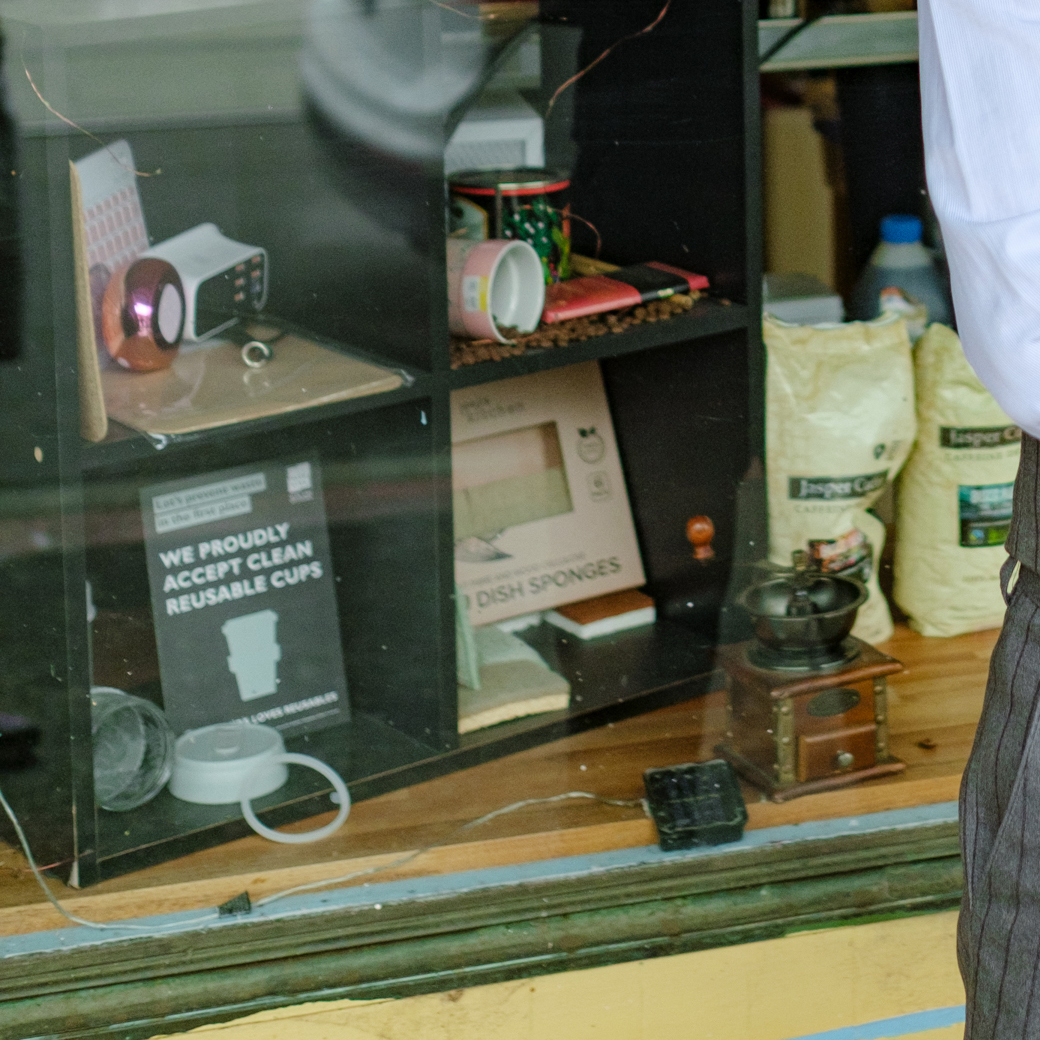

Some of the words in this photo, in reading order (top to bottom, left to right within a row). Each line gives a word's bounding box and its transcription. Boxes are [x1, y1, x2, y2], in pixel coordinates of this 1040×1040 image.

[799, 479, 851, 499] Jasper
[159, 545, 195, 569] WE
[198, 522, 290, 560] PROUDLY
[163, 557, 243, 593] ACCEPT
[246, 539, 313, 571] CLEAN
[165, 574, 268, 616] REUSABLE
[270, 561, 324, 589] CUPS
[476, 579, 525, 610] DISH
[528, 555, 623, 595] SPONGES
